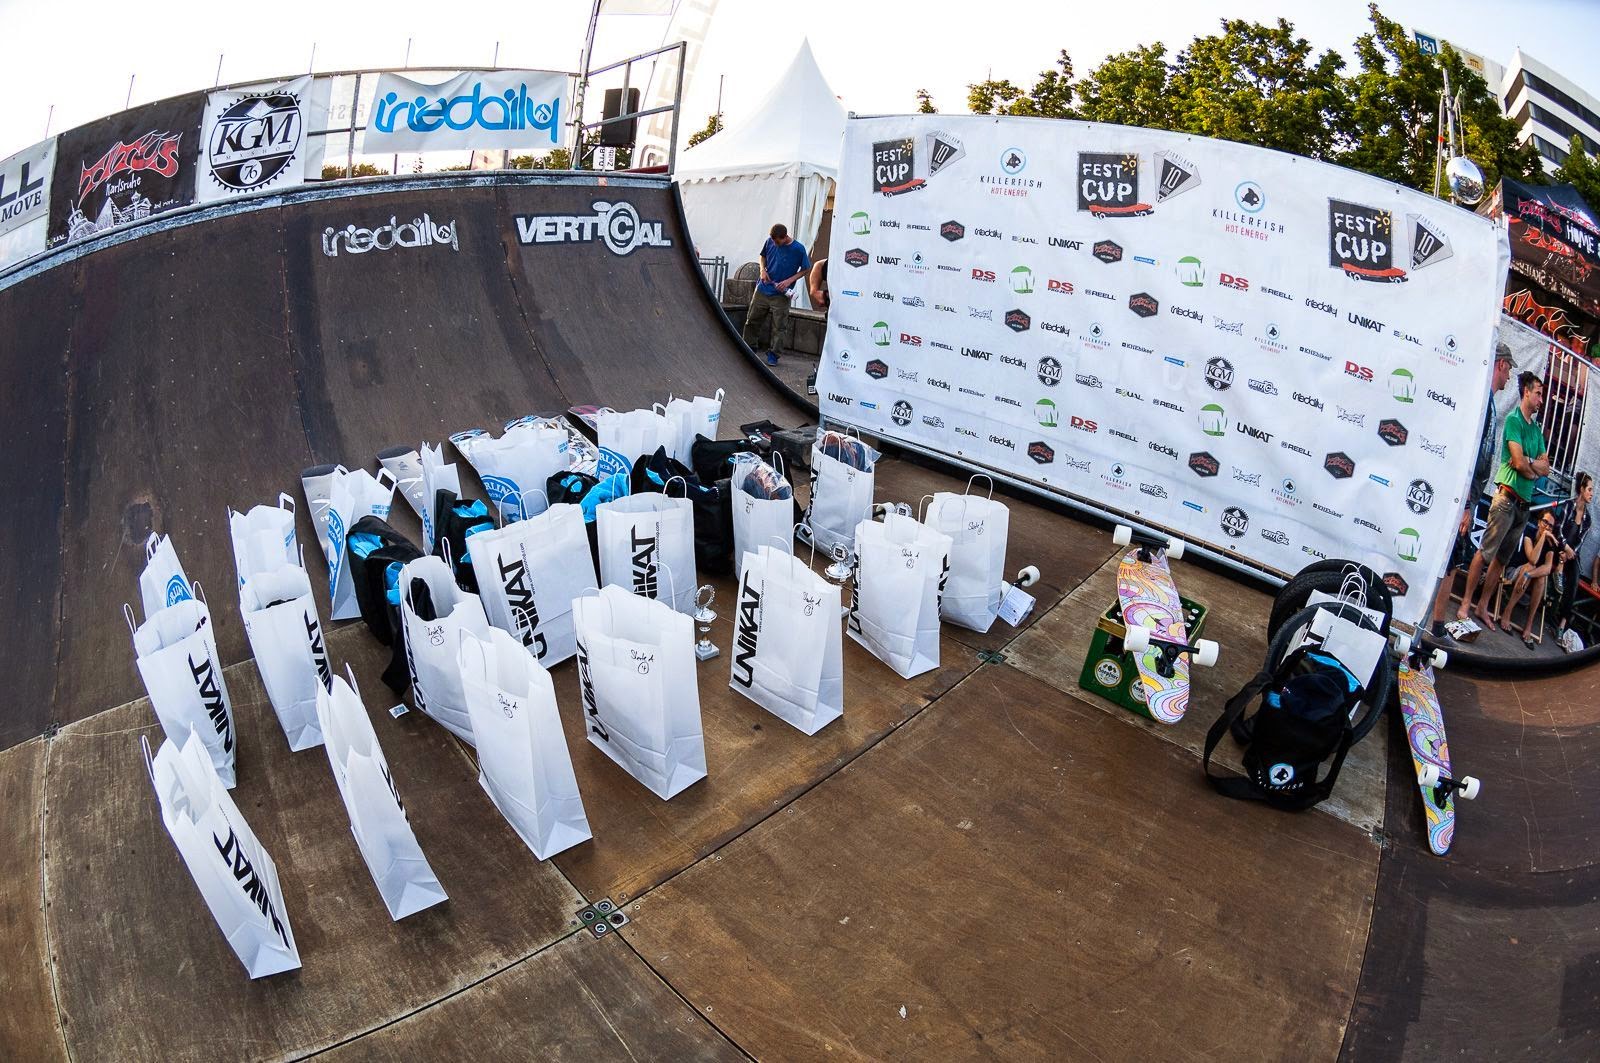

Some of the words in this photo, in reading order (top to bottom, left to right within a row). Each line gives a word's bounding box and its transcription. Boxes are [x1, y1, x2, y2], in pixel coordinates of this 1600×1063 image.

[213, 112, 298, 157] KGM
[876, 148, 902, 163] FEST
[934, 144, 949, 163] 10
[876, 162, 909, 184] CUP
[1082, 163, 1123, 178] FEST
[1164, 166, 1180, 190] 10
[105, 172, 142, 196] Karlsruhe
[980, 176, 1043, 188] KILLERFISH
[1082, 179, 1132, 202] CUP
[1, 190, 42, 223] MOVE
[515, 200, 672, 256] VERTICAL
[1212, 208, 1284, 234] KILLERFISH
[1334, 212, 1377, 235] FEST
[1225, 224, 1239, 234] HOT
[1240, 226, 1269, 242] ENERGY
[1567, 220, 1595, 254] HOME
[1048, 237, 1083, 250] UNIKAT
[1334, 232, 1387, 264] CUP
[1417, 231, 1435, 256] 10
[972, 269, 996, 280] DS
[1220, 273, 1248, 288] DS
[1048, 280, 1073, 292] DS
[1268, 288, 1293, 300] REELL
[1349, 312, 1385, 332] UNIKAT
[900, 332, 922, 343] DS
[961, 347, 993, 361] UNIKAT
[1039, 362, 1061, 378] KGM
[1207, 367, 1232, 382] KGM
[1346, 360, 1374, 379] DS
[828, 392, 853, 405] UNIKAT
[1160, 400, 1184, 412] REELL
[1071, 416, 1097, 430] DS
[1237, 422, 1274, 443] UNIKAT
[1115, 431, 1139, 442] REELL
[1288, 444, 1312, 457] REELL
[1409, 486, 1432, 506] KGM
[1223, 514, 1246, 530] KGM
[1360, 520, 1383, 533] REELL
[631, 524, 657, 600] IKAT
[497, 552, 548, 661] UNIKAT
[733, 570, 762, 689] UNIKAT
[188, 652, 234, 755] NIKAT
